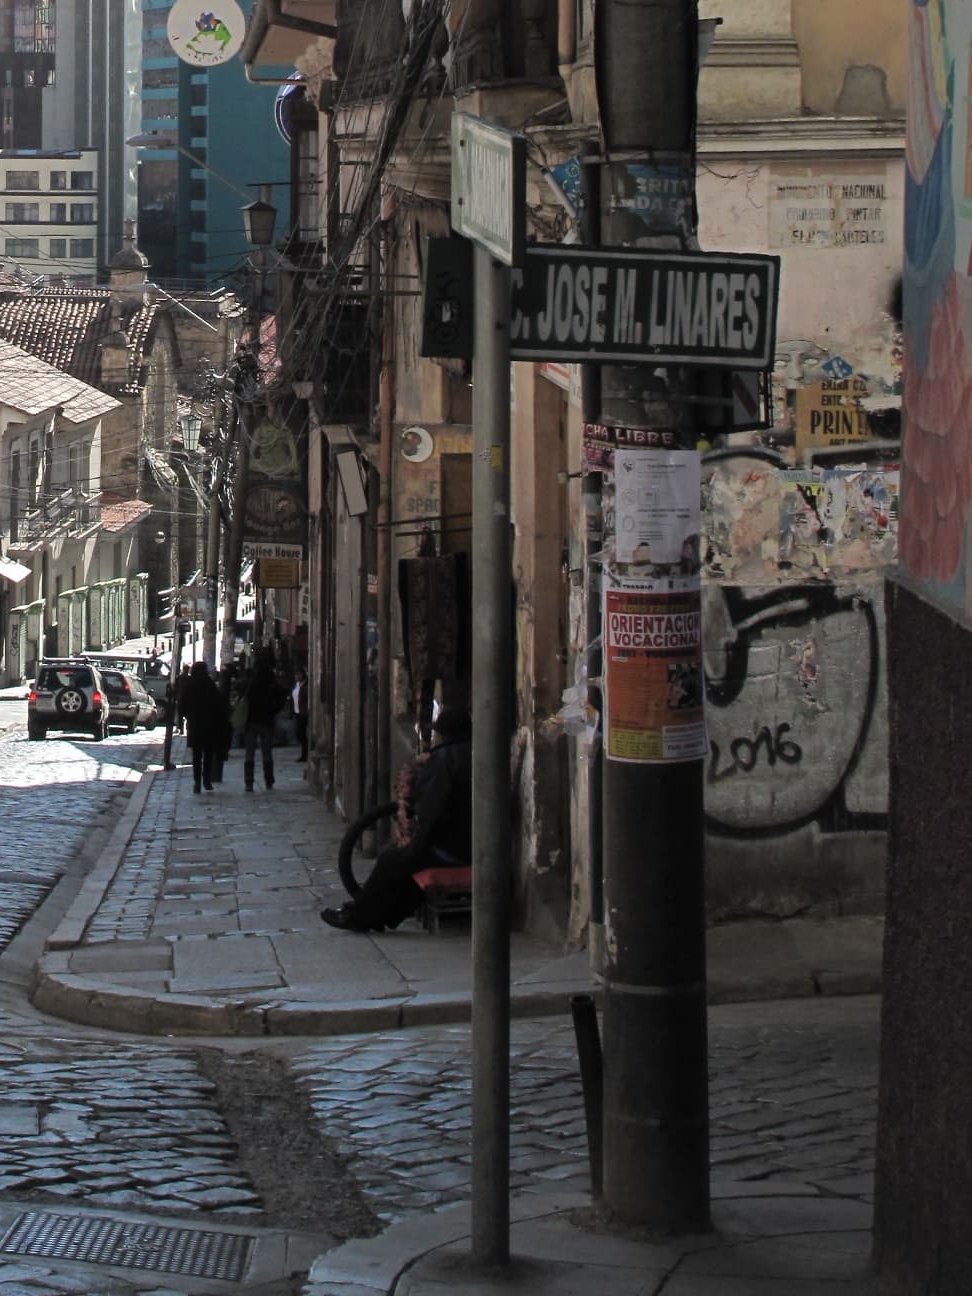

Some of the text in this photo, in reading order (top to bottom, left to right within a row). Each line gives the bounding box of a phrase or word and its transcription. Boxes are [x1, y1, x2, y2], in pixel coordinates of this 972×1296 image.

[842, 184, 886, 200] NACIONAL
[510, 263, 761, 351] C. JOSE M. LINARES
[614, 426, 676, 446] LIBRE
[243, 545, 300, 558] Coffee House
[611, 615, 700, 634] ORIENTACION
[613, 632, 699, 647] VOCACIONAL
[708, 722, 803, 784] 2016
